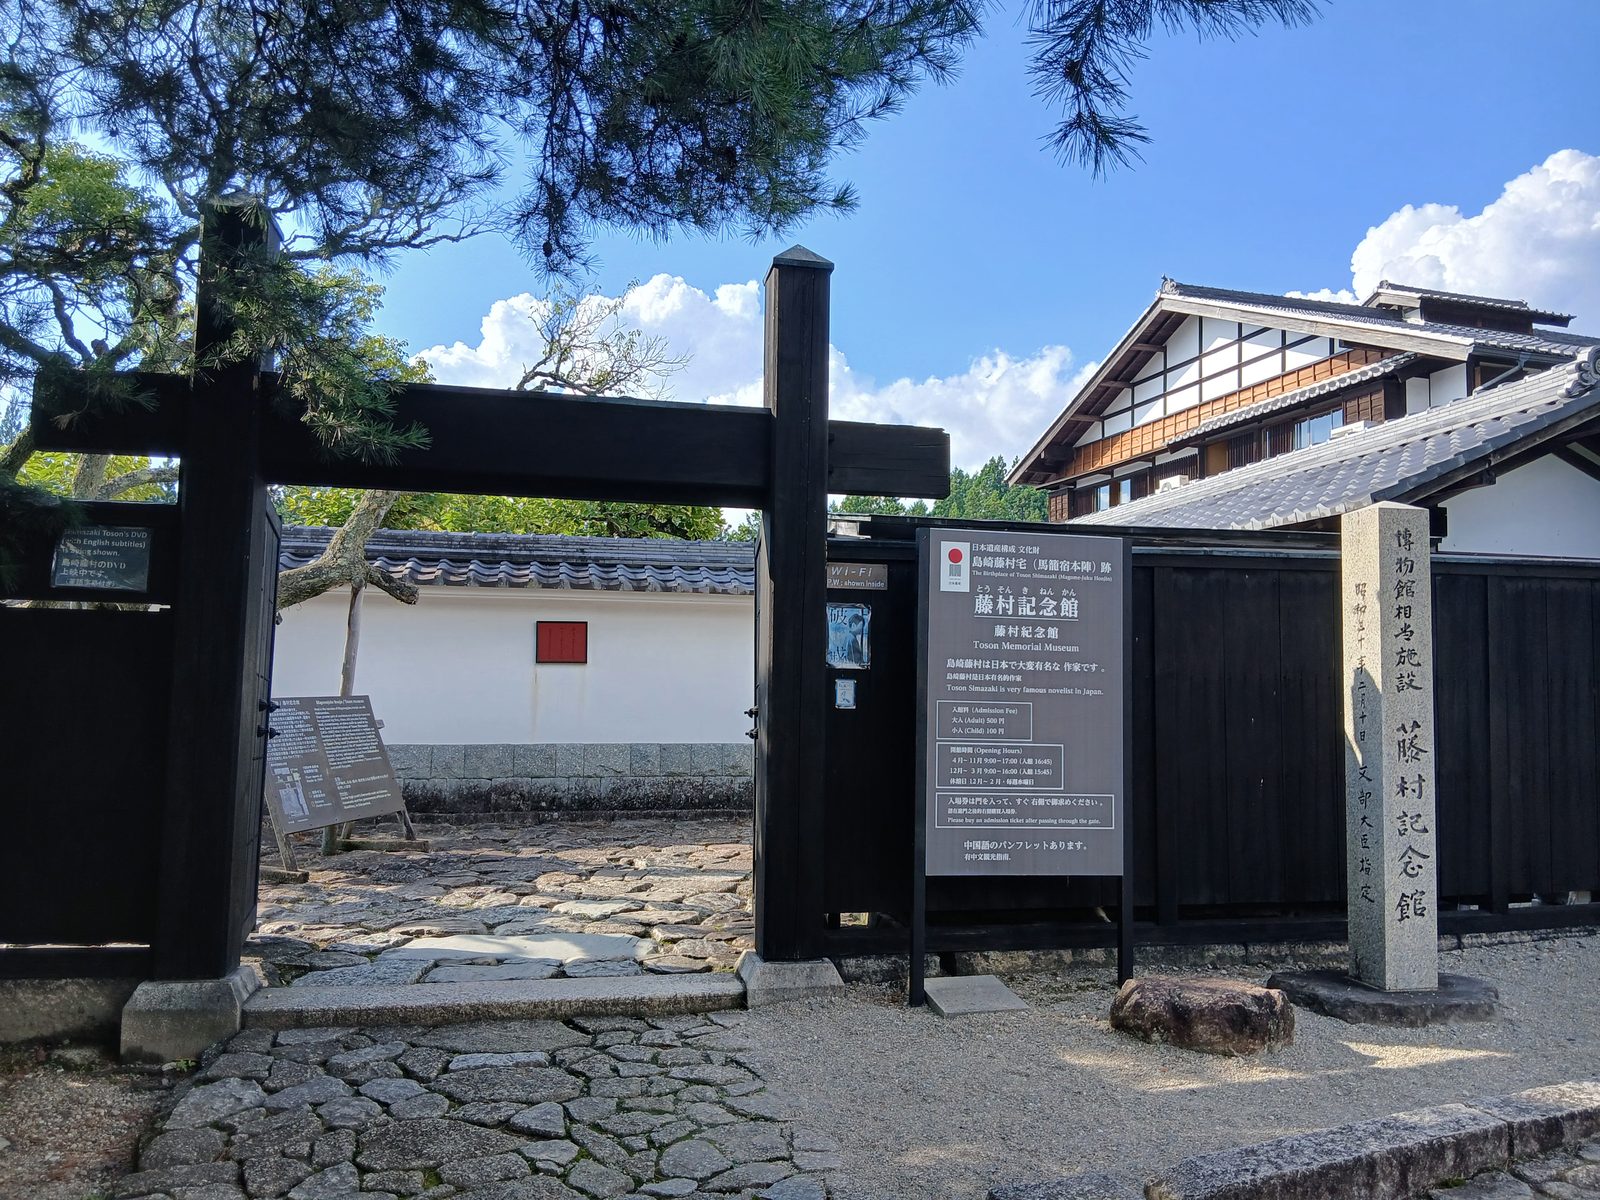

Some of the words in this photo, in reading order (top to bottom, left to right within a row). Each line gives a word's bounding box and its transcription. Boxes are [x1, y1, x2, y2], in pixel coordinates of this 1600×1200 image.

[83, 539, 110, 548] English
[112, 540, 146, 548] subtitles)
[93, 548, 120, 556] shown.
[974, 594, 1078, 618] 藤村記念館
[1393, 528, 1423, 693] 博物館相当施設
[973, 640, 999, 650] Toson
[1002, 642, 1041, 651] Memorial
[1044, 643, 1079, 652] Museum
[969, 684, 998, 692] Simazaki
[1023, 686, 1046, 694] famous
[1082, 688, 1104, 696] Japan.
[1395, 720, 1430, 922] 藤村記念館
[1358, 766, 1374, 904] 文部大臣指定
